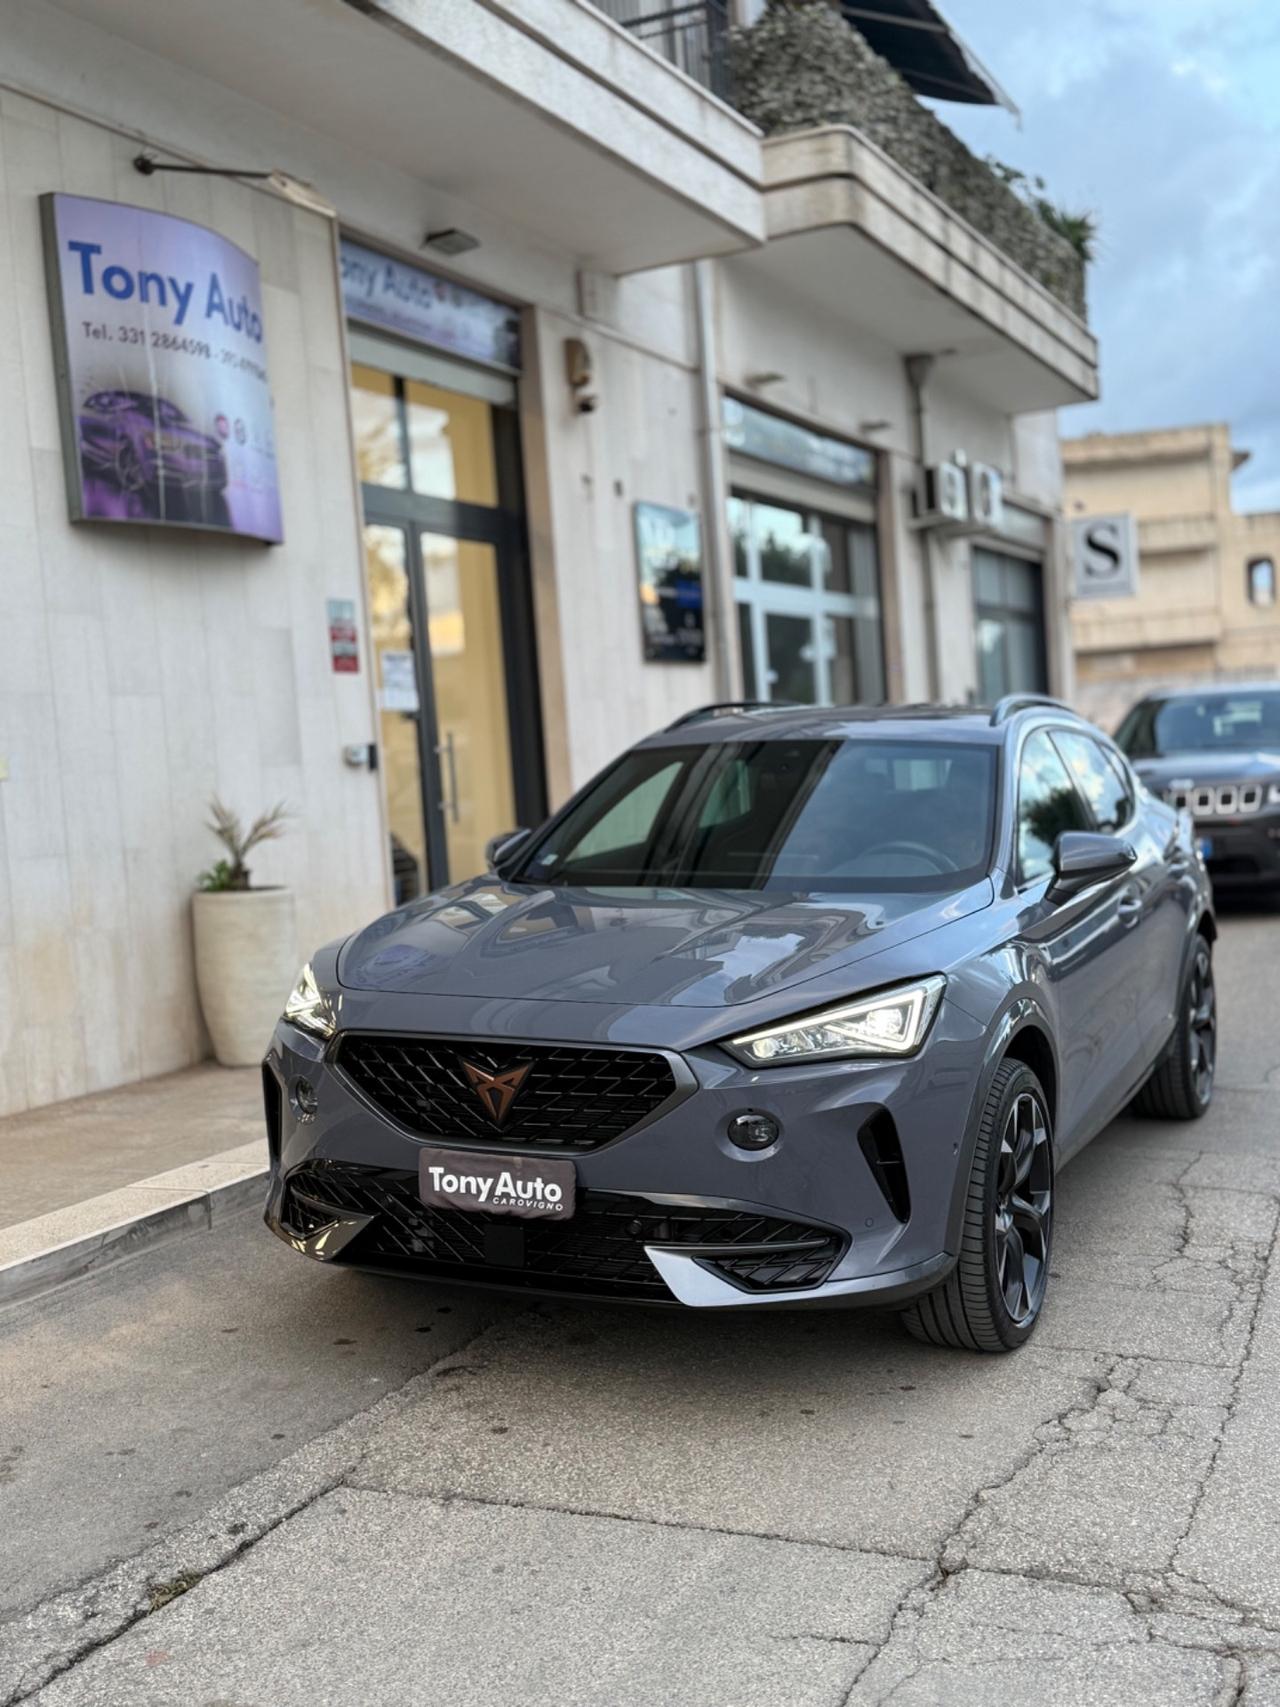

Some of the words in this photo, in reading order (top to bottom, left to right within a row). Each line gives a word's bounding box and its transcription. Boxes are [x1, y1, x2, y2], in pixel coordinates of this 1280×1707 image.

[68, 240, 194, 325] Tony
[204, 272, 263, 344] Auto
[82, 321, 113, 341] Tel.
[118, 325, 145, 345] 331
[1083, 520, 1122, 580] S
[492, 1197, 564, 1212] CAROVIGNO
